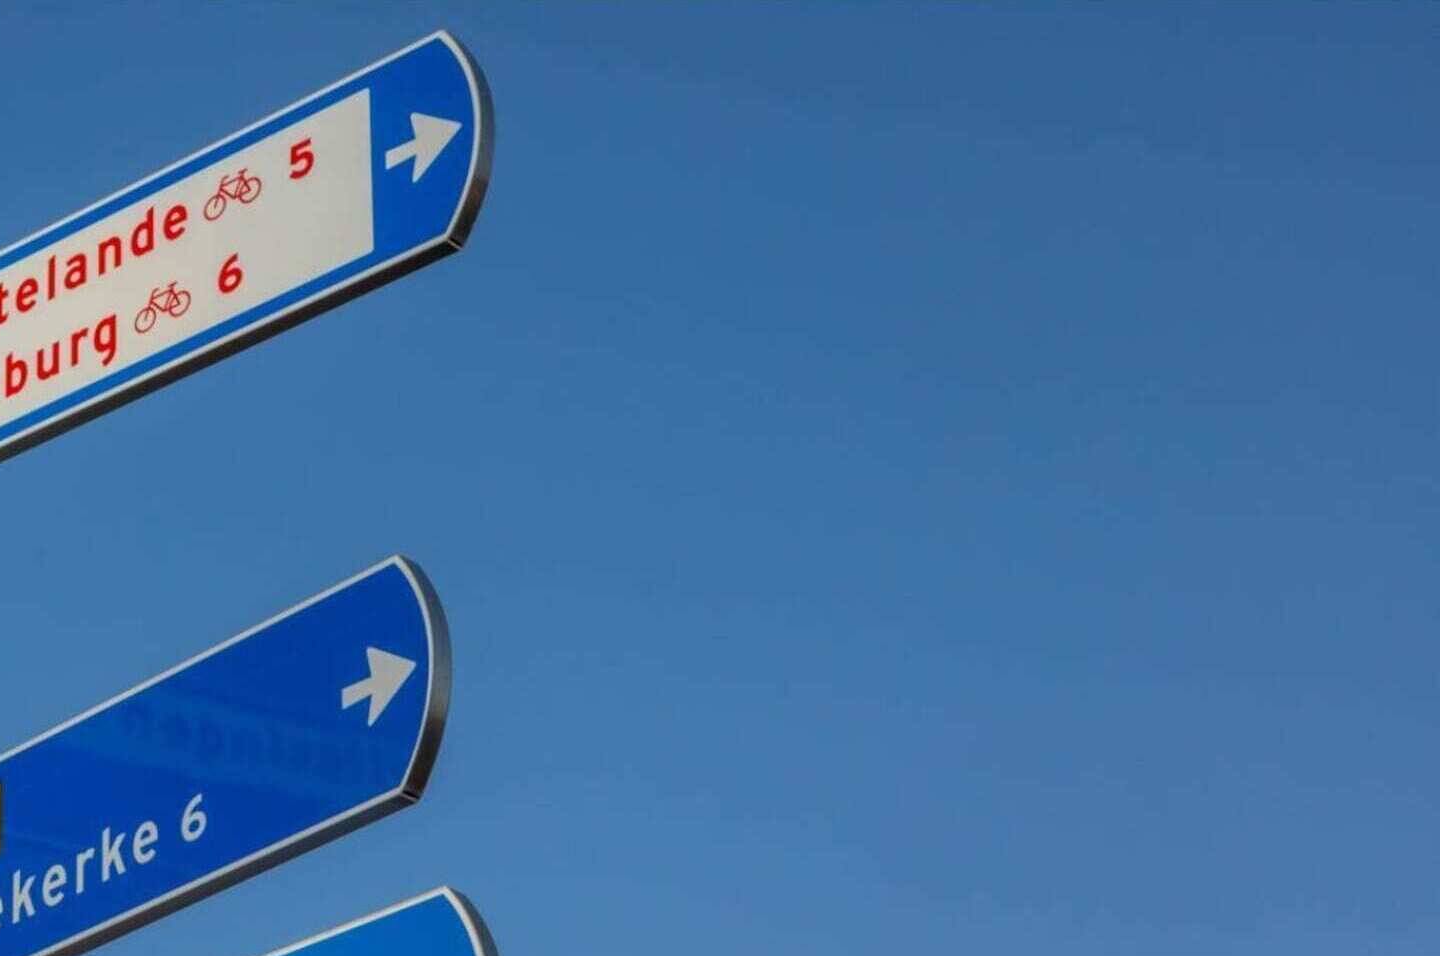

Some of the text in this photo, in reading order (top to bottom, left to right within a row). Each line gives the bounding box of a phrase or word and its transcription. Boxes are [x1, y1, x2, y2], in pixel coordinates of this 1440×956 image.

[289, 138, 316, 180] 5
[216, 253, 244, 295] 6
[181, 794, 207, 841] 6
